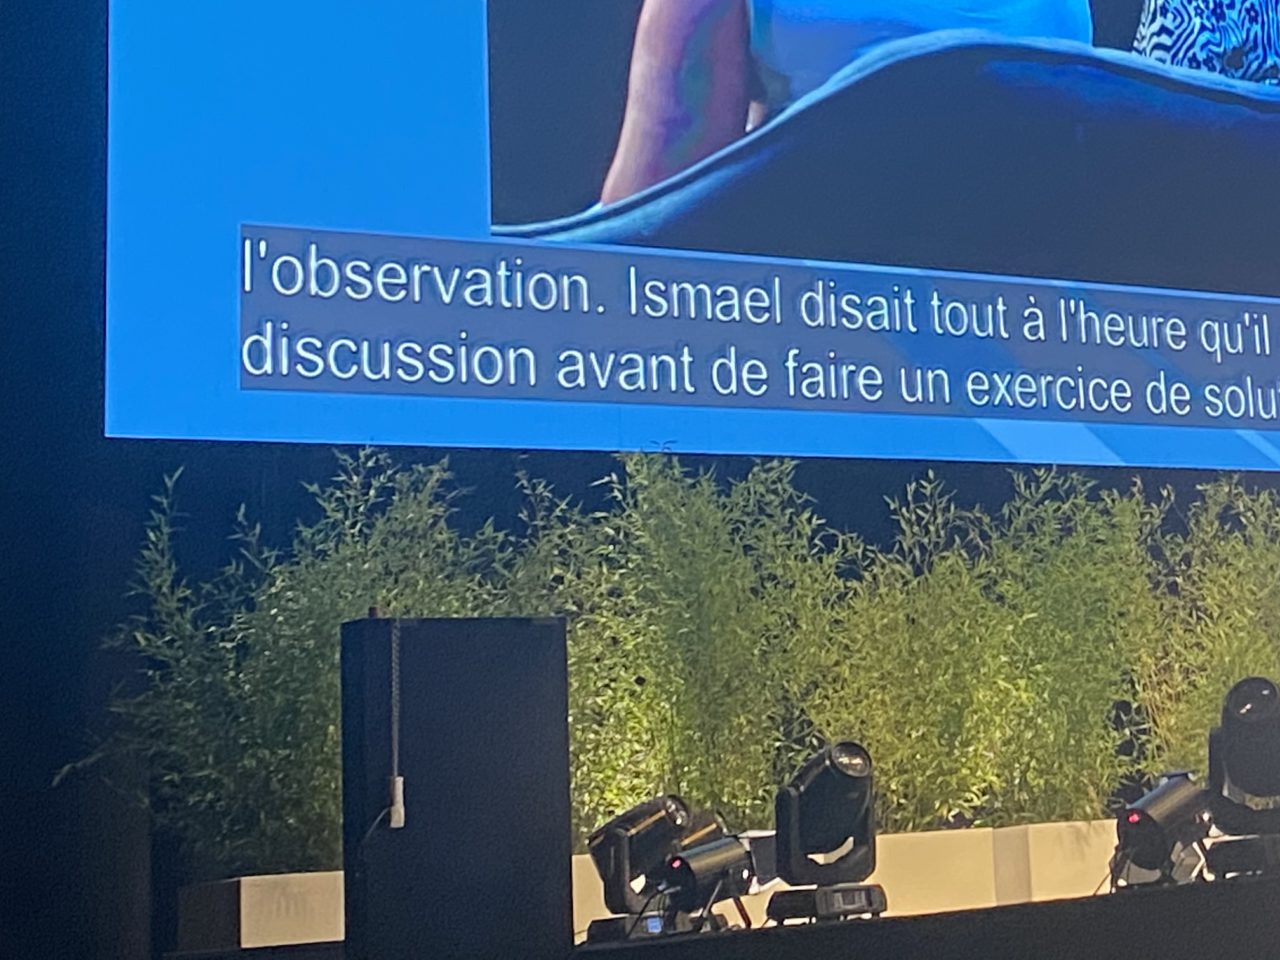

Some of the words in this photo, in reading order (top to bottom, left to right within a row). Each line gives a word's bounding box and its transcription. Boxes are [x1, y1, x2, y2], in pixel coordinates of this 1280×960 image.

[245, 240, 605, 312] l'observation.
[630, 267, 780, 324] Ismael
[801, 281, 916, 331] disait
[931, 292, 1008, 338] tout
[1022, 296, 1044, 340] à
[1060, 299, 1186, 349] l'heure
[1201, 313, 1269, 363] qu'il
[243, 322, 535, 385] discussion
[558, 347, 694, 392] avant
[712, 347, 767, 395] de
[785, 349, 882, 400] faire
[901, 368, 949, 402] un
[967, 366, 1131, 412] exercice
[1146, 371, 1190, 414] de
